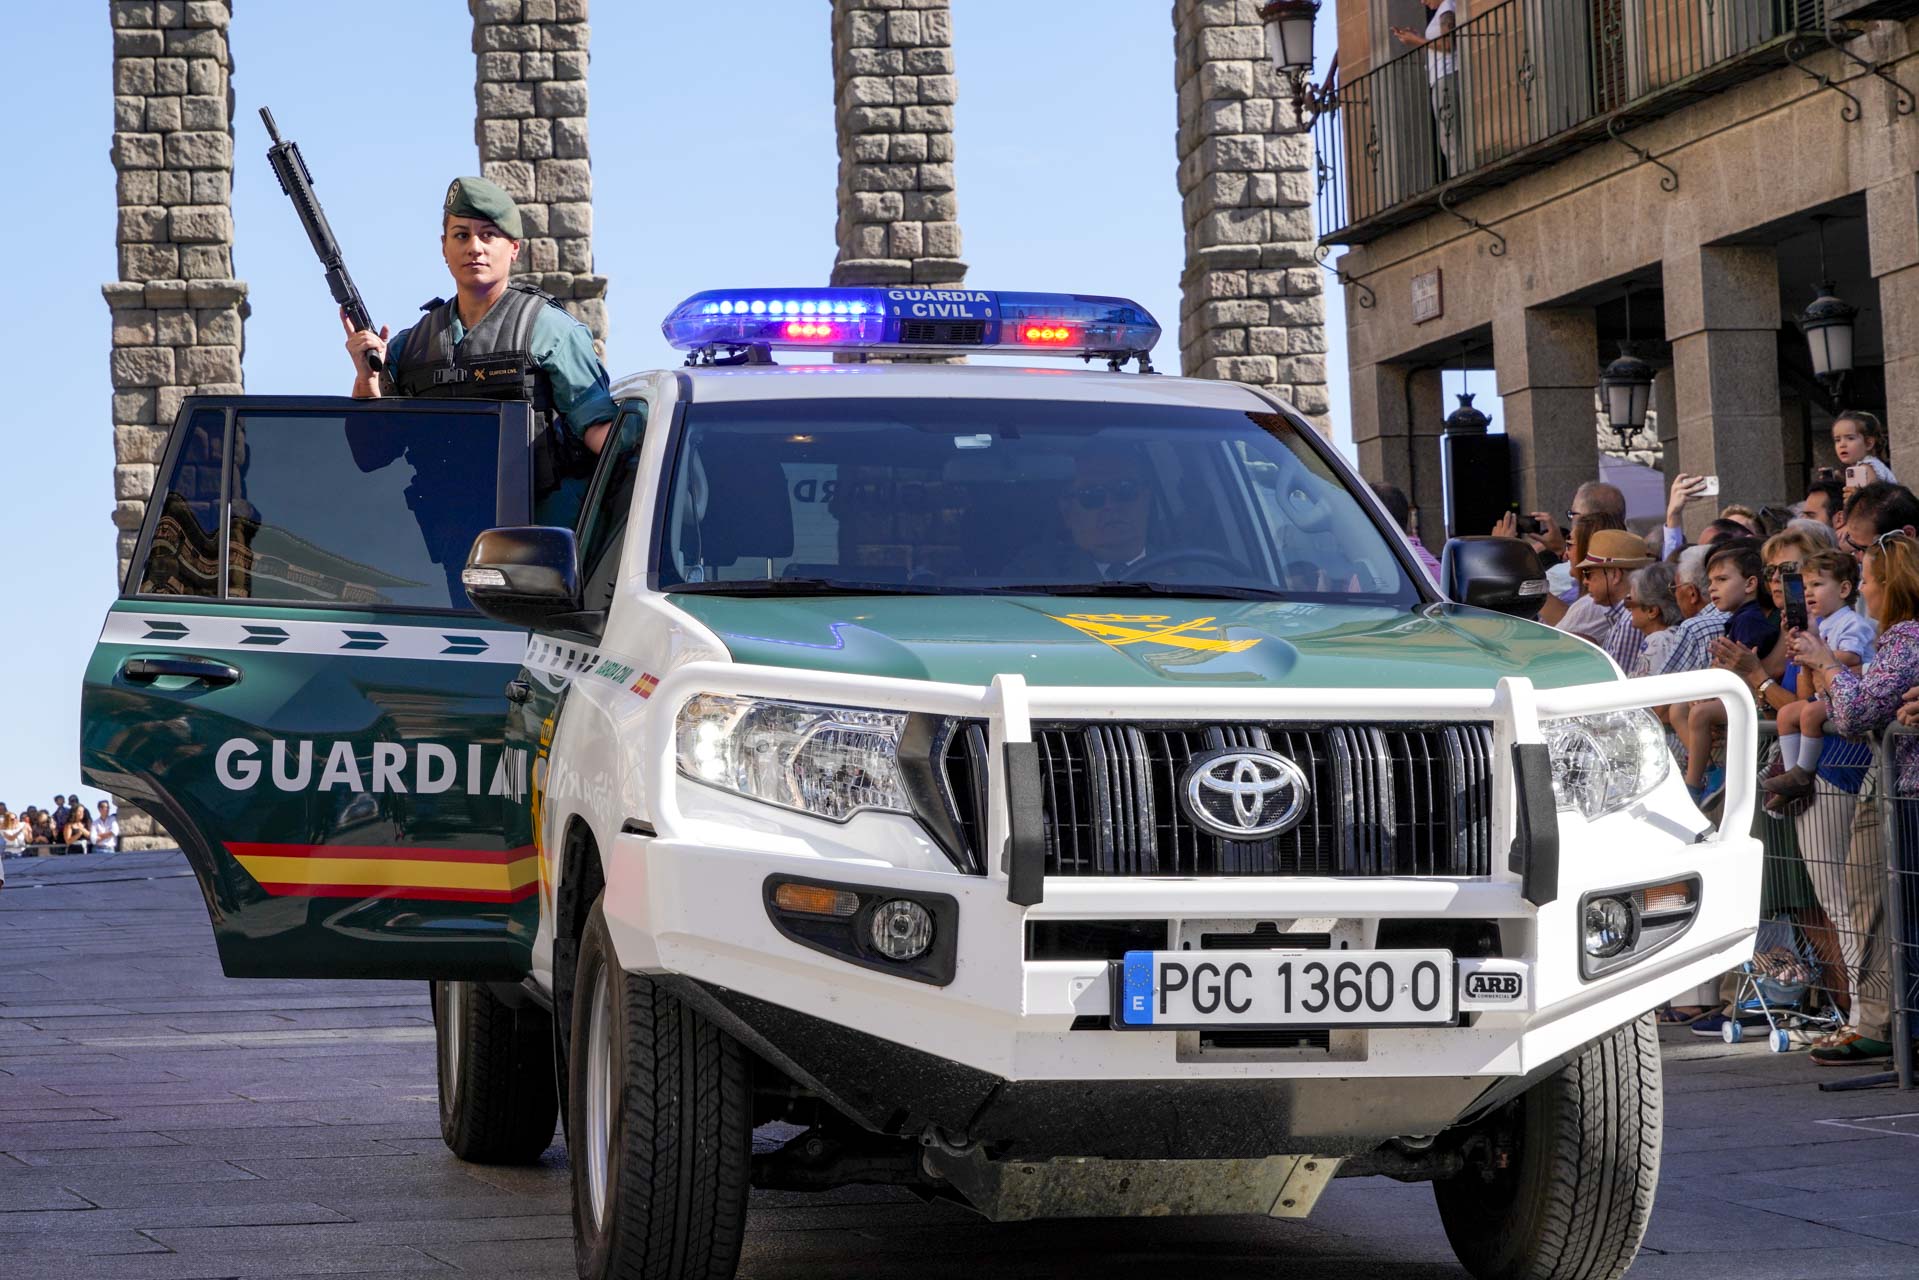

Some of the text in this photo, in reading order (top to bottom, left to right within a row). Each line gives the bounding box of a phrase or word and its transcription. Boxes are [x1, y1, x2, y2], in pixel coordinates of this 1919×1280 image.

[888, 290, 990, 302] GUARDIA
[912, 303, 973, 317] CIVIL
[1160, 962, 1253, 1014] PGC
[1472, 976, 1517, 993] ARB
[1133, 996, 1145, 1011] E
